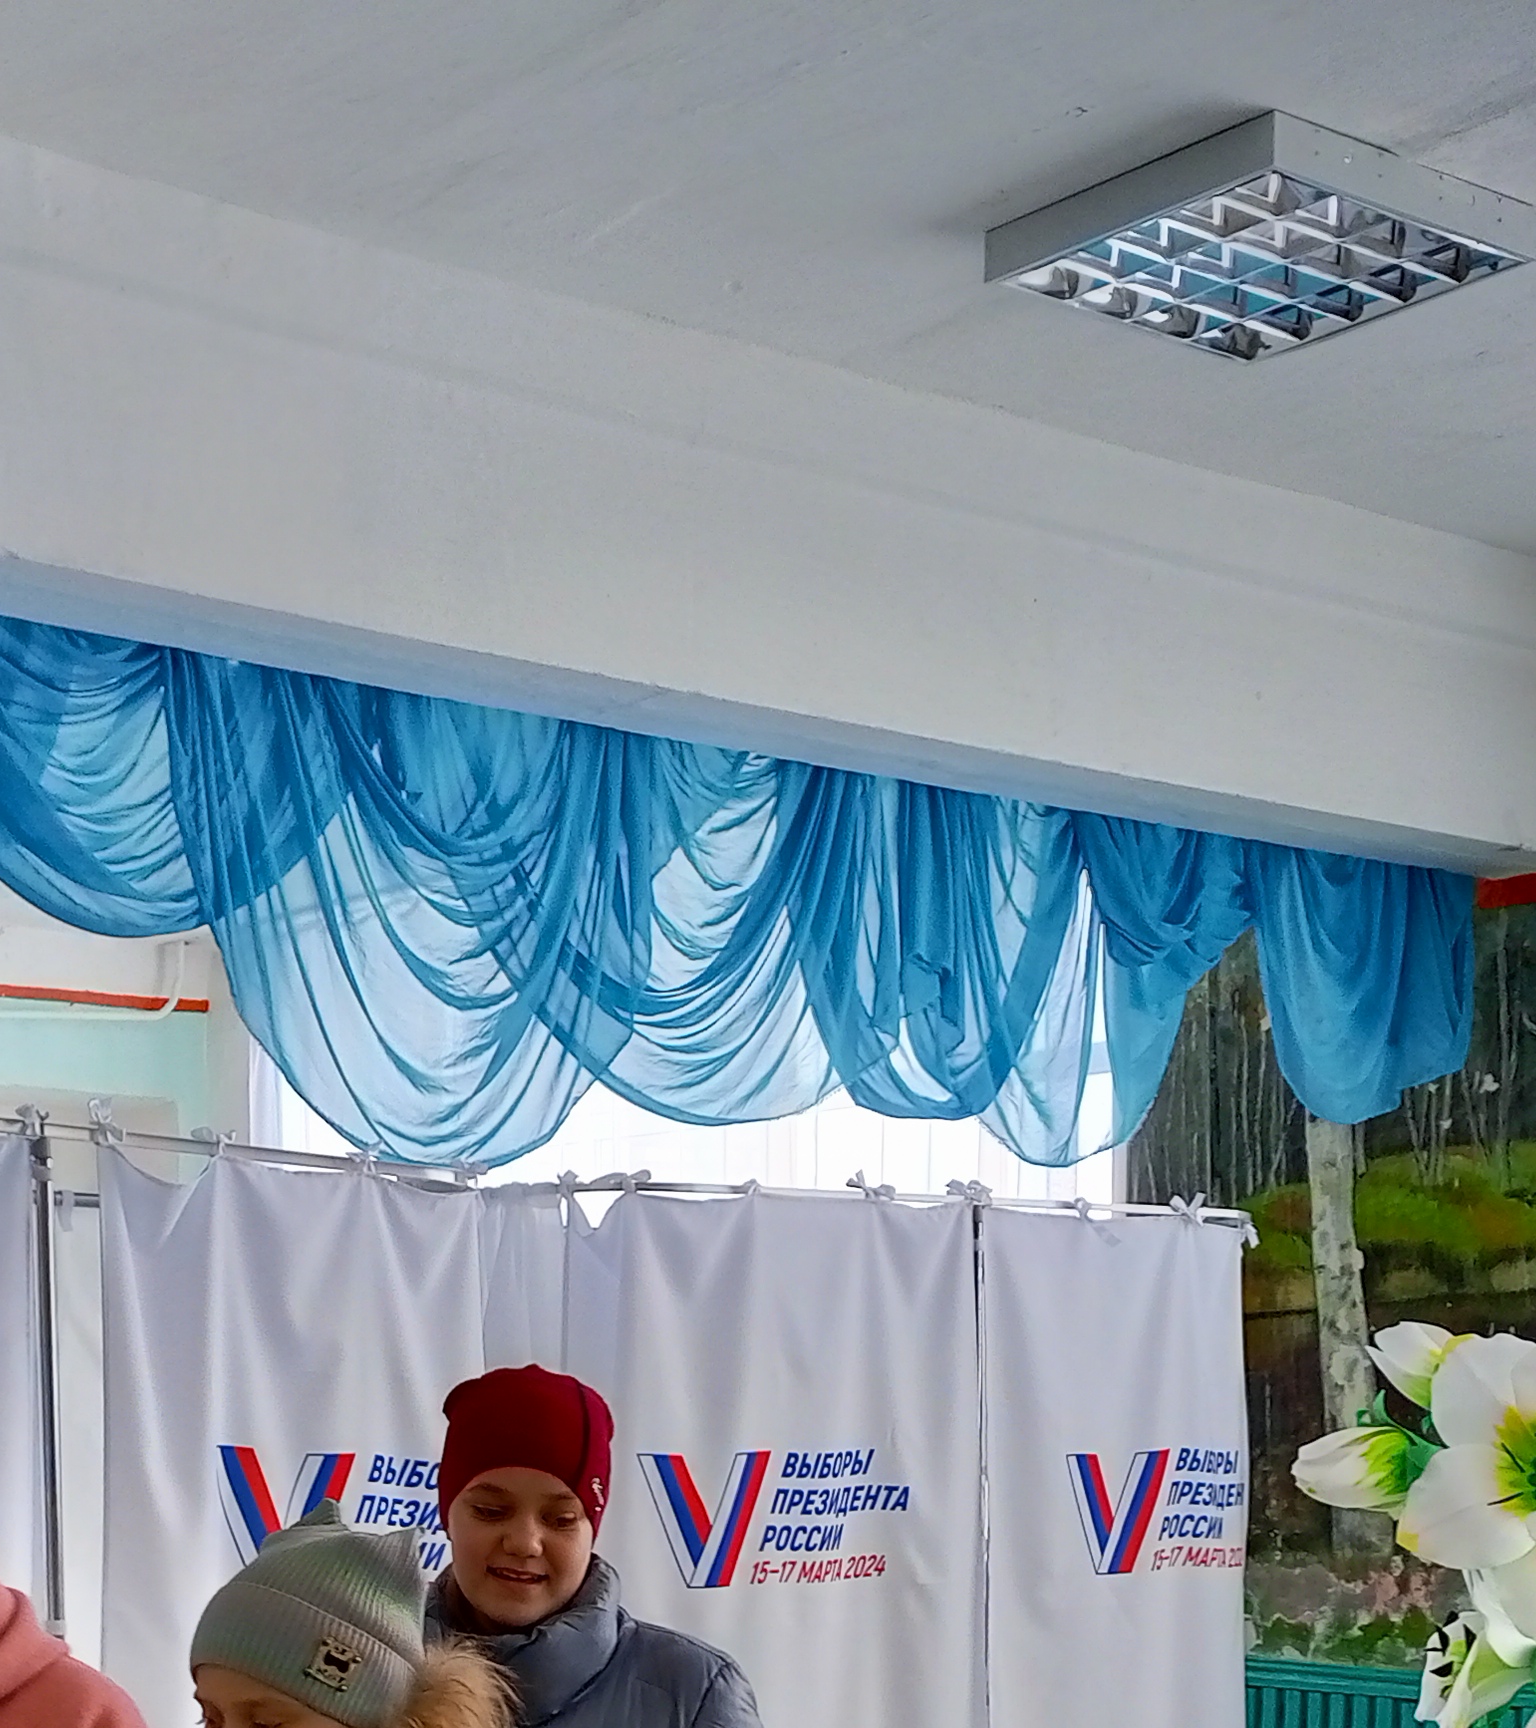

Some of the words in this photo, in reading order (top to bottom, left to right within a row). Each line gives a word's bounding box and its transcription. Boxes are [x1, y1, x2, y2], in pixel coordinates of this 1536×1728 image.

[367, 1454, 441, 1490] ВЫБО
[781, 1449, 875, 1479] ВЫБОРЫ
[770, 1484, 910, 1518] ПРЕЗИДЕНТА
[758, 1523, 844, 1552] РОССИИ
[796, 1558, 843, 1583] МАРТА
[843, 1554, 886, 1579] 2024
